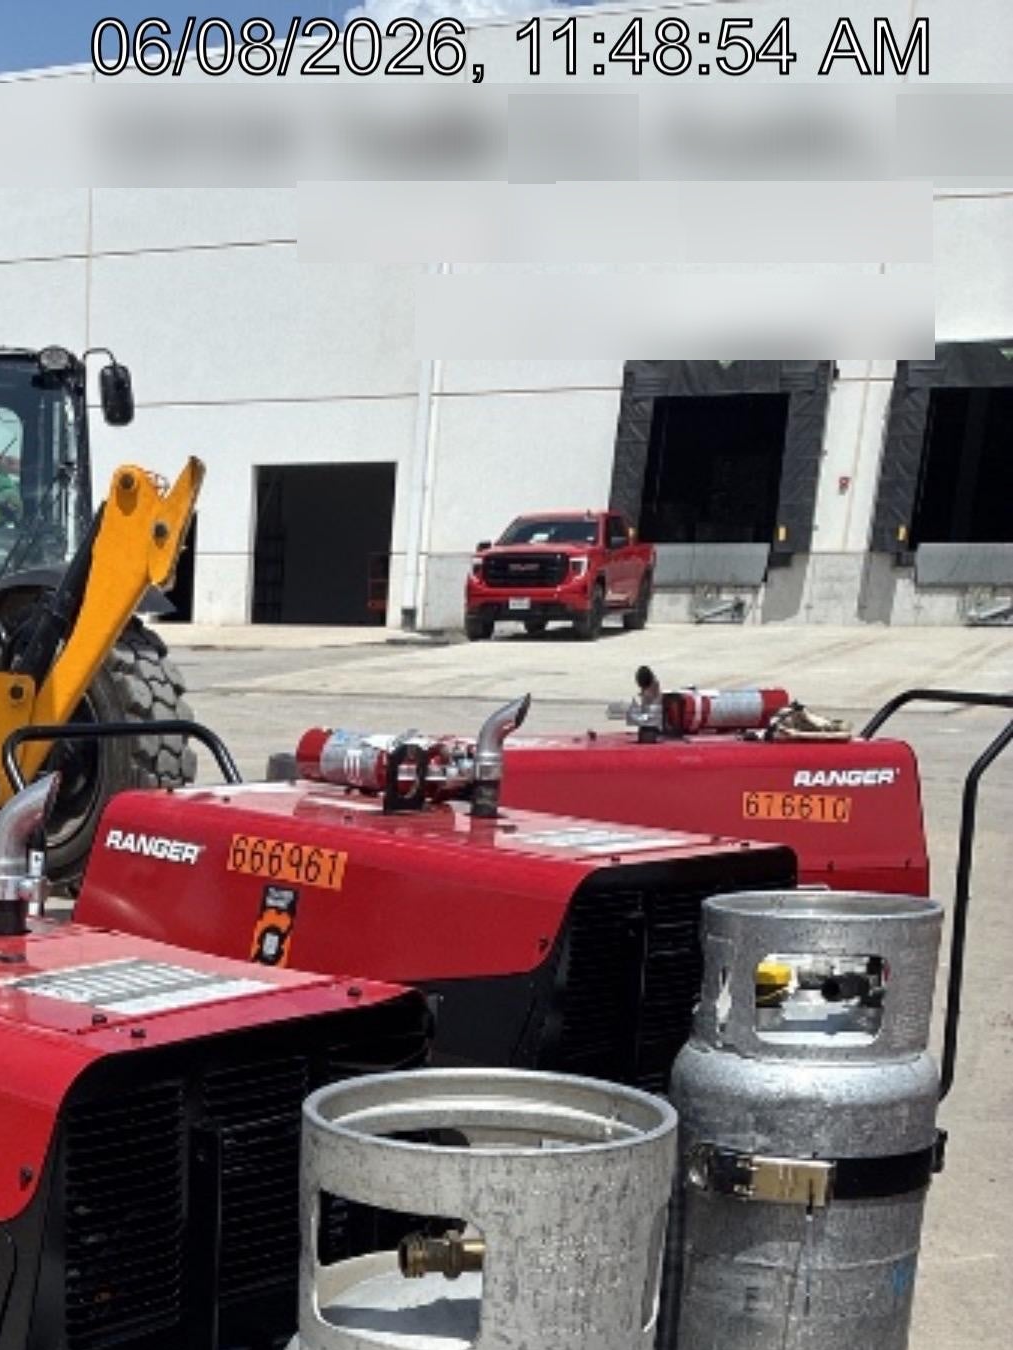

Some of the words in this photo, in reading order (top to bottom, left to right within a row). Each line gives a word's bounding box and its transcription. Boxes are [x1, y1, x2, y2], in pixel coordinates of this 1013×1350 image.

[793, 768, 895, 787] RANGER
[745, 791, 847, 820] 676610
[105, 829, 200, 865] RANGER
[232, 836, 338, 887] 666961
